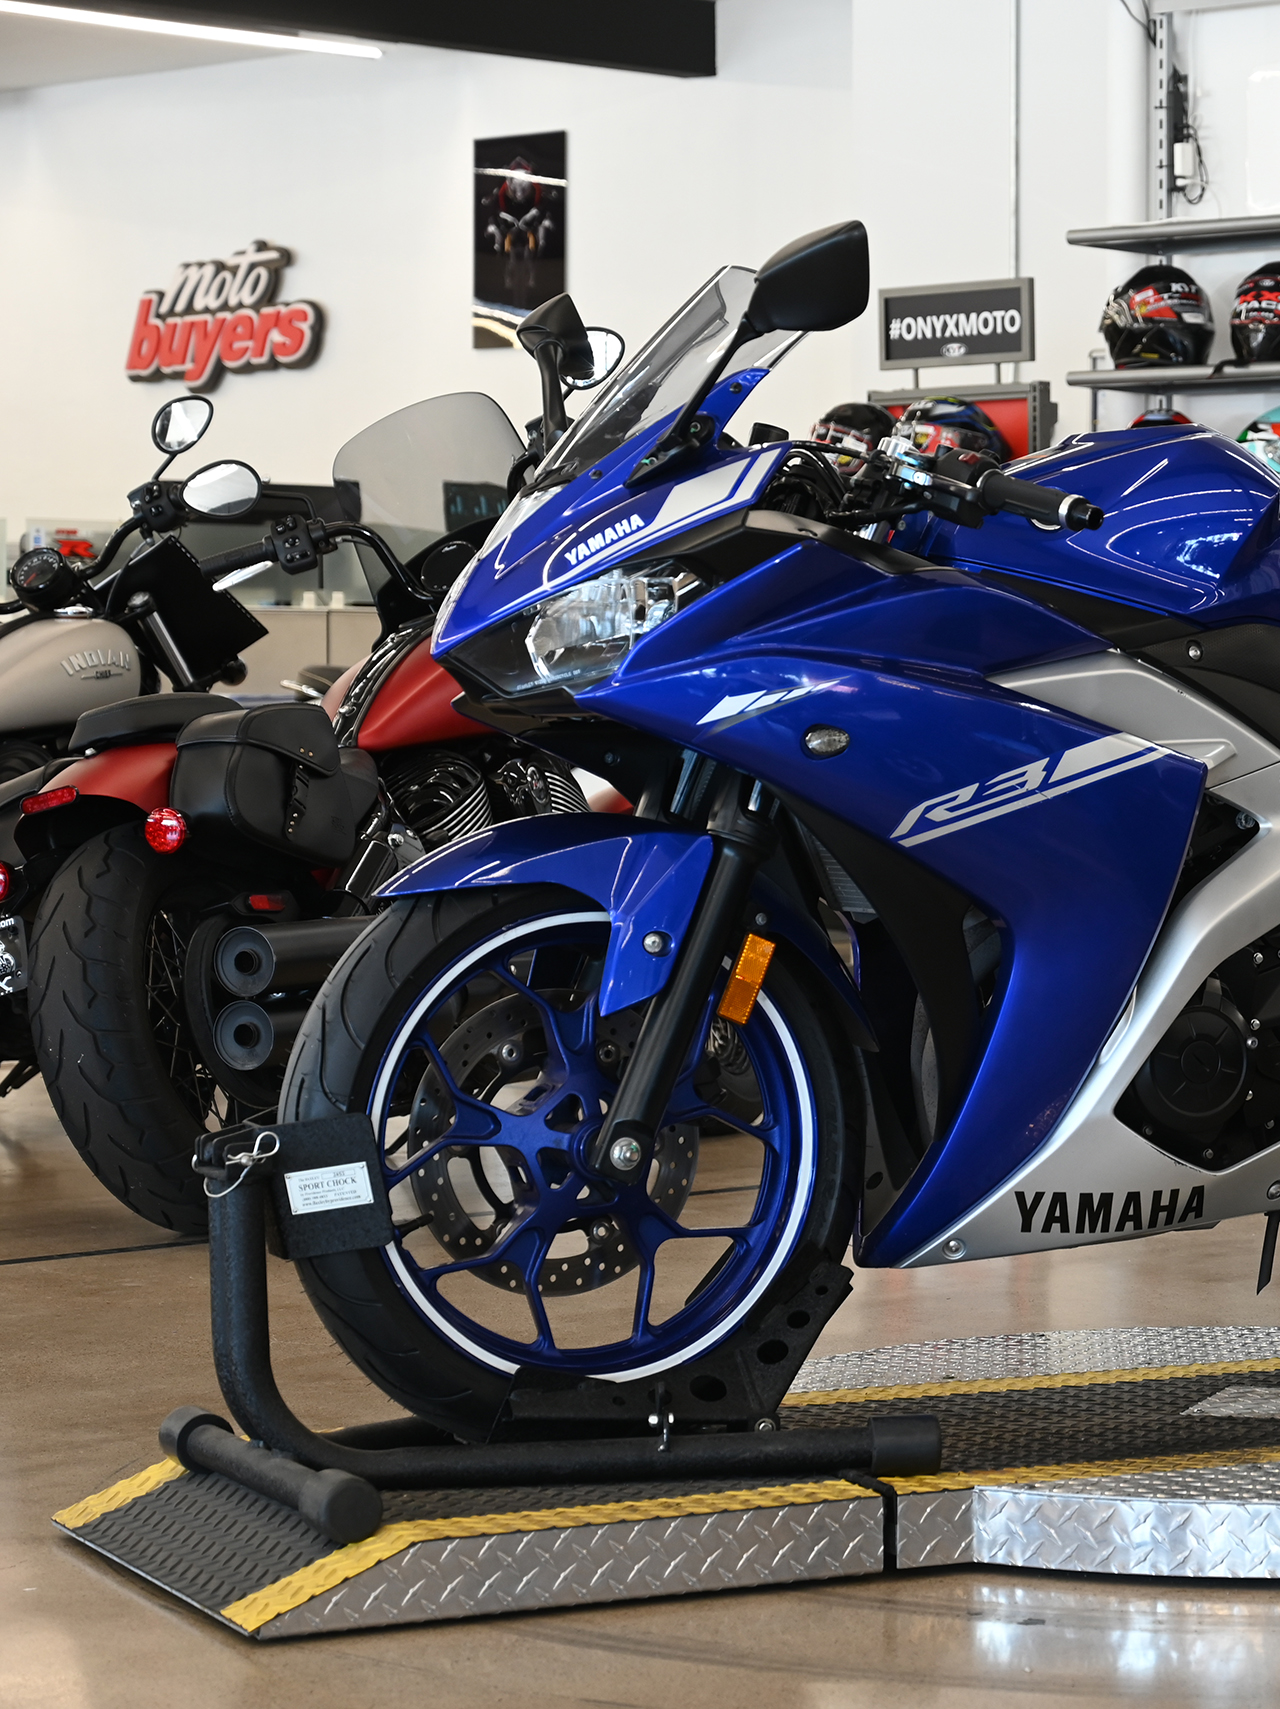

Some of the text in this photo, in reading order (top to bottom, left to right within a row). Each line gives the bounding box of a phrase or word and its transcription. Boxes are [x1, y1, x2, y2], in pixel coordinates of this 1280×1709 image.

[125, 295, 313, 385] buyers
[889, 309, 1022, 341] #ONYXMOTO
[564, 513, 645, 566] YAMAHA
[60, 649, 131, 676] INDIAN
[298, 1176, 357, 1191] SPORT CHOCK
[1014, 1185, 1205, 1234] YAMAHA
